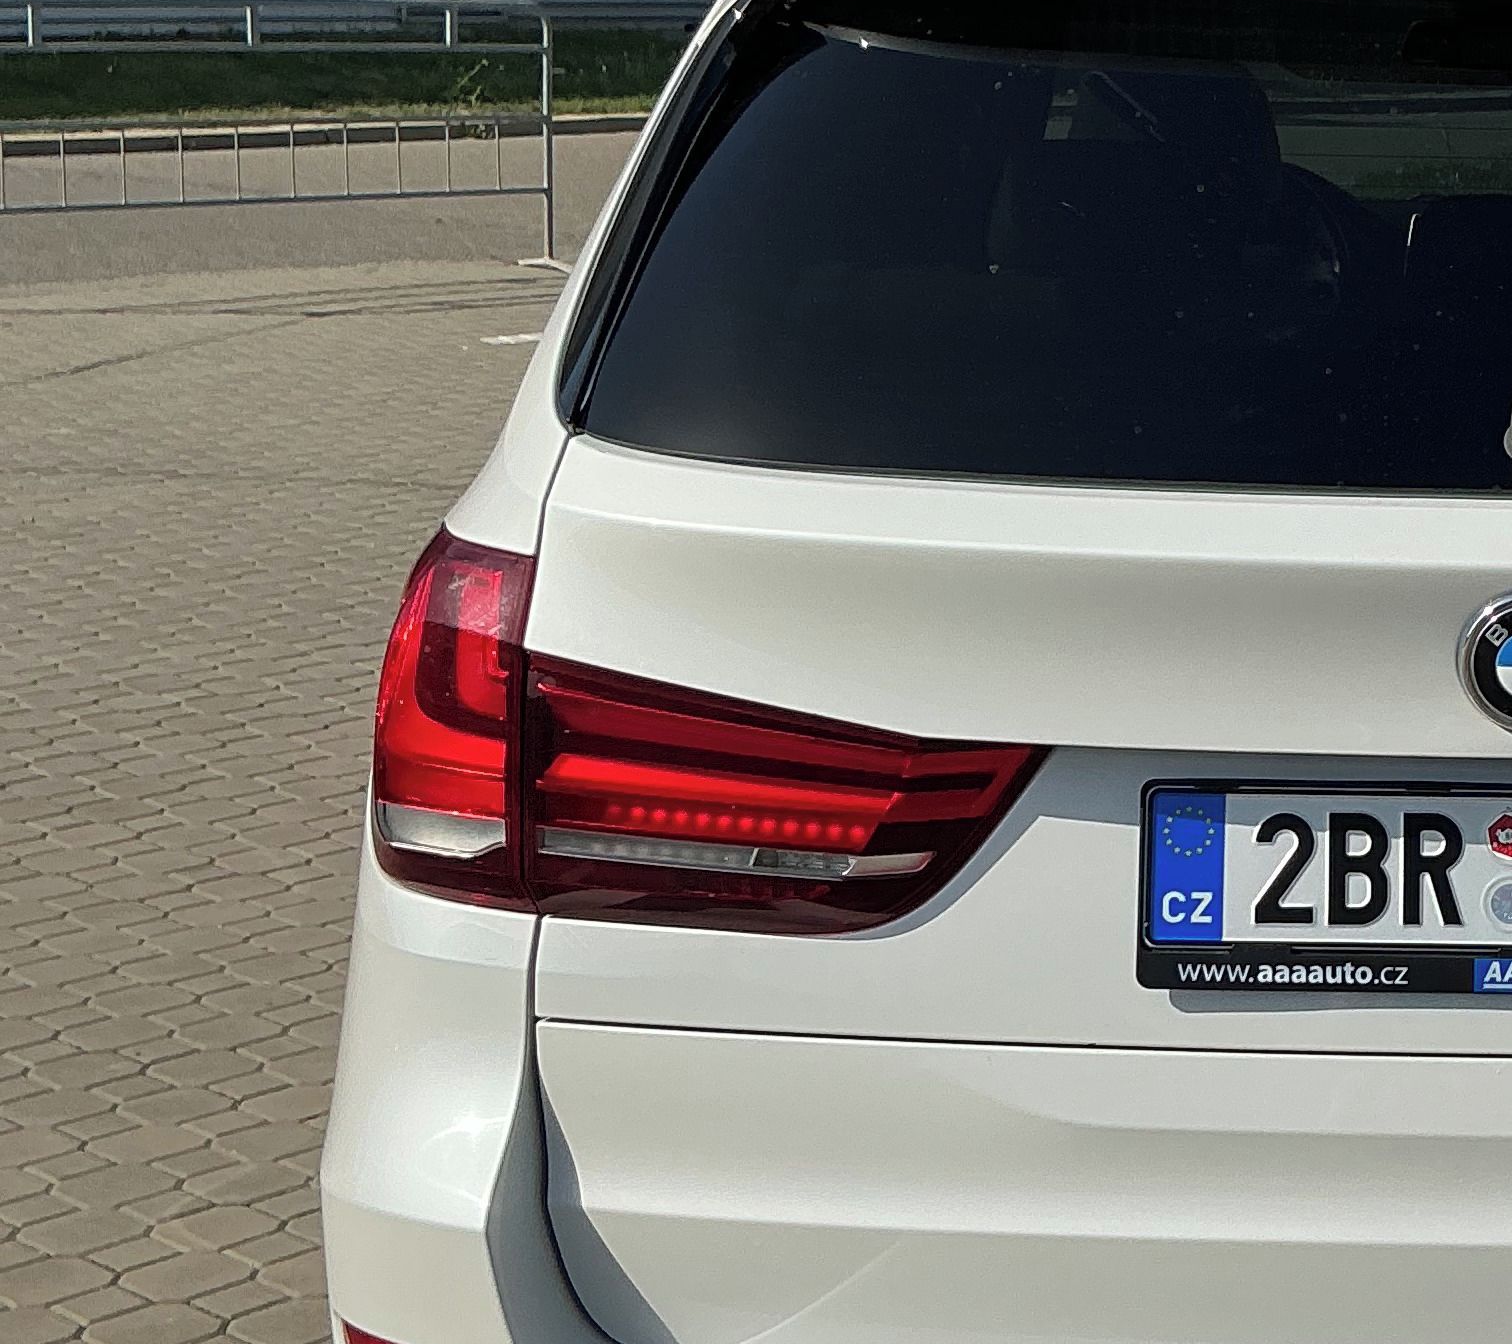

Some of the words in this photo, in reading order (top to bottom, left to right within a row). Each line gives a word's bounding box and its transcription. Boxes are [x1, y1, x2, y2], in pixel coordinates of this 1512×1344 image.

[1254, 812, 1464, 927] 2BR
[1162, 890, 1213, 923] CZ
[1177, 960, 1409, 986] www.aaaauto.cz
